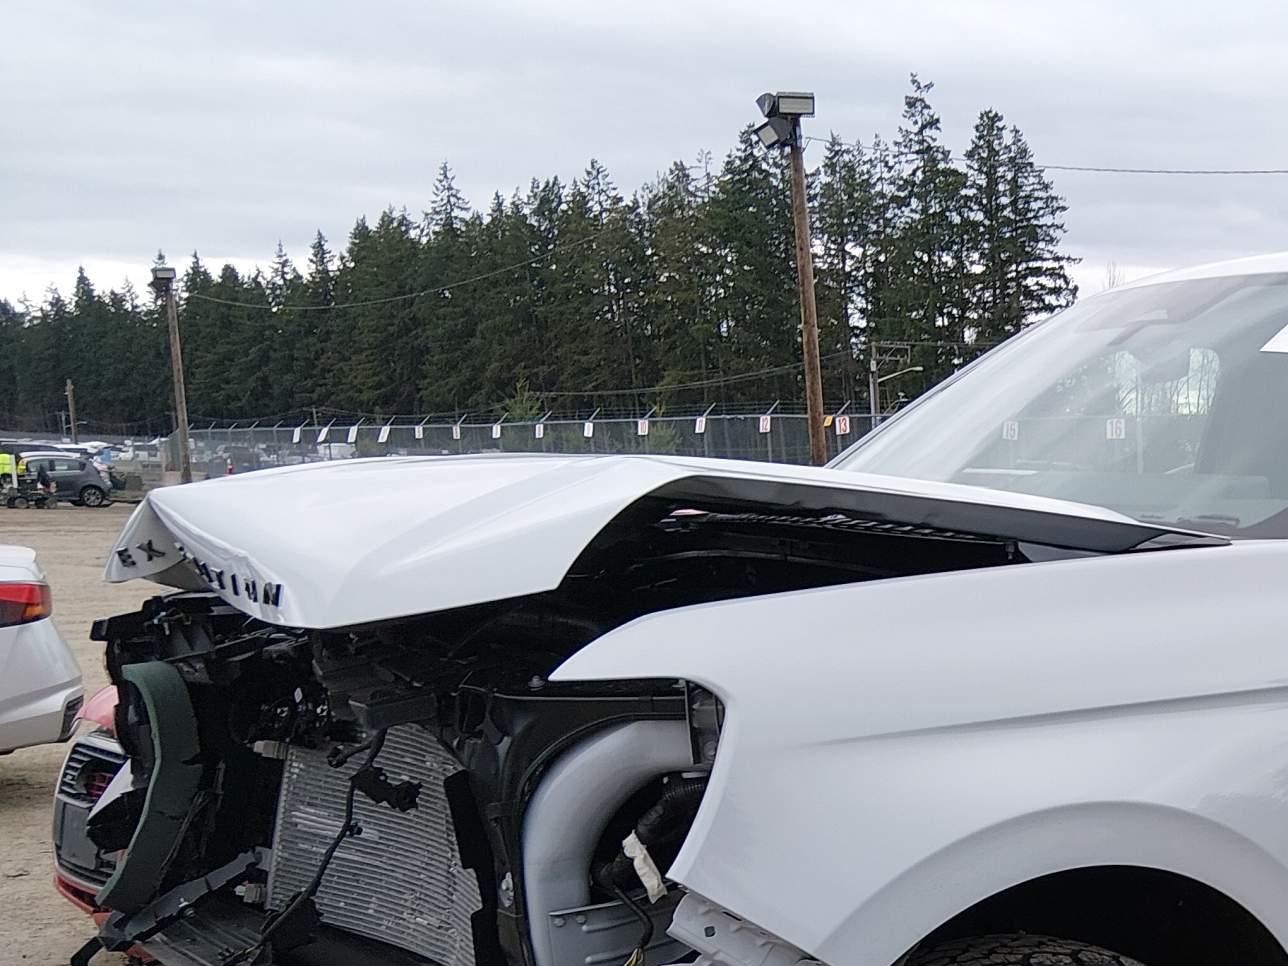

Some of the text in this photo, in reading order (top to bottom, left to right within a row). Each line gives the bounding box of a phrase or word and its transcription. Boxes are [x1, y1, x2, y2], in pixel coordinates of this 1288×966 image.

[761, 416, 769, 431] 12
[838, 417, 848, 433] 13
[1005, 421, 1016, 439] 15
[1108, 419, 1122, 438] 16
